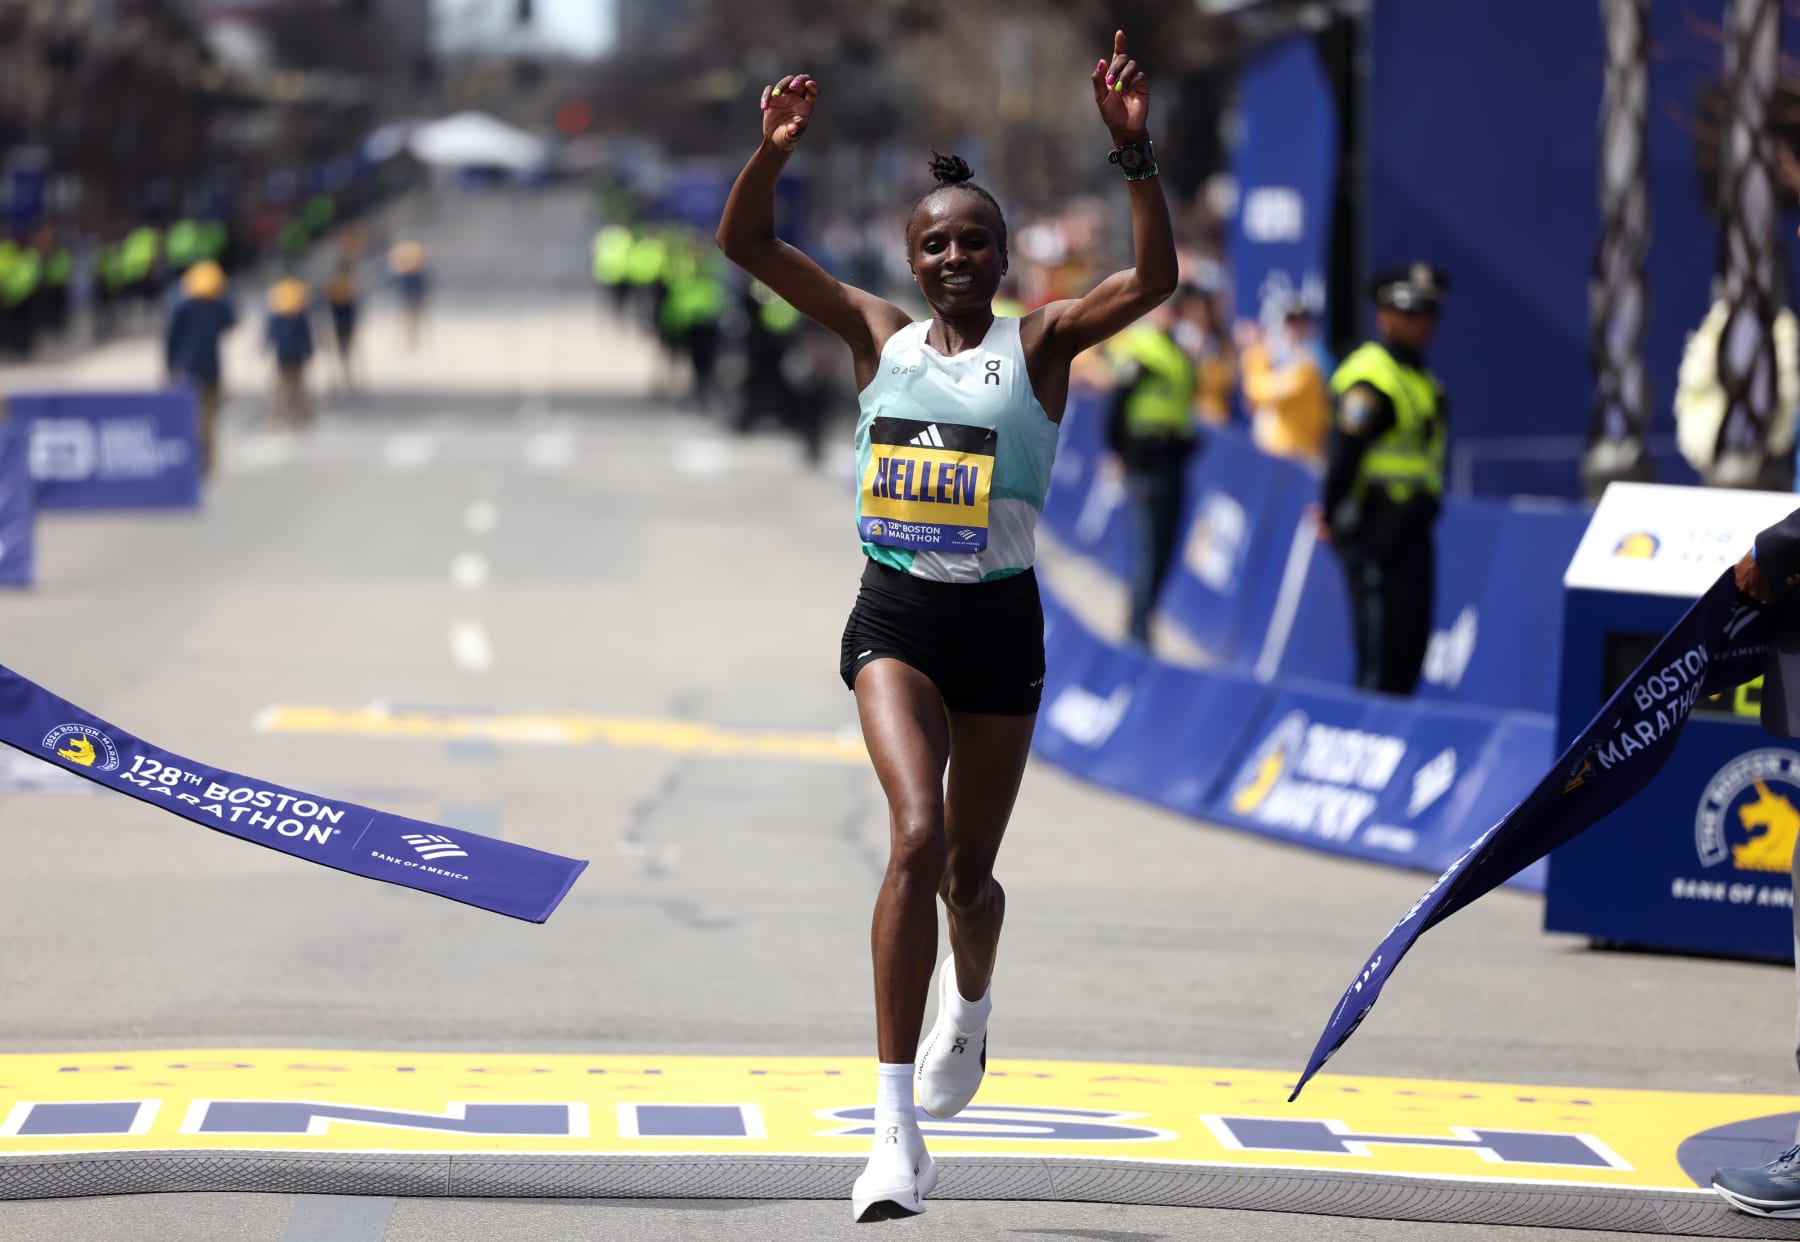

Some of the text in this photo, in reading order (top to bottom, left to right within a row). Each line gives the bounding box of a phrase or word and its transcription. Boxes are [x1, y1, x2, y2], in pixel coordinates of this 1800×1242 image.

[872, 457, 979, 507] HELLEN
[888, 530, 941, 544] MARATHON
[902, 524, 941, 535] BOSTON
[1633, 644, 1709, 712] BOSTON
[60, 726, 99, 737] BOSTON
[1597, 672, 1706, 770] MARATHO
[130, 755, 345, 824] 128TH BOSTON
[371, 850, 402, 865] BANK
[419, 865, 469, 880] AMERICA
